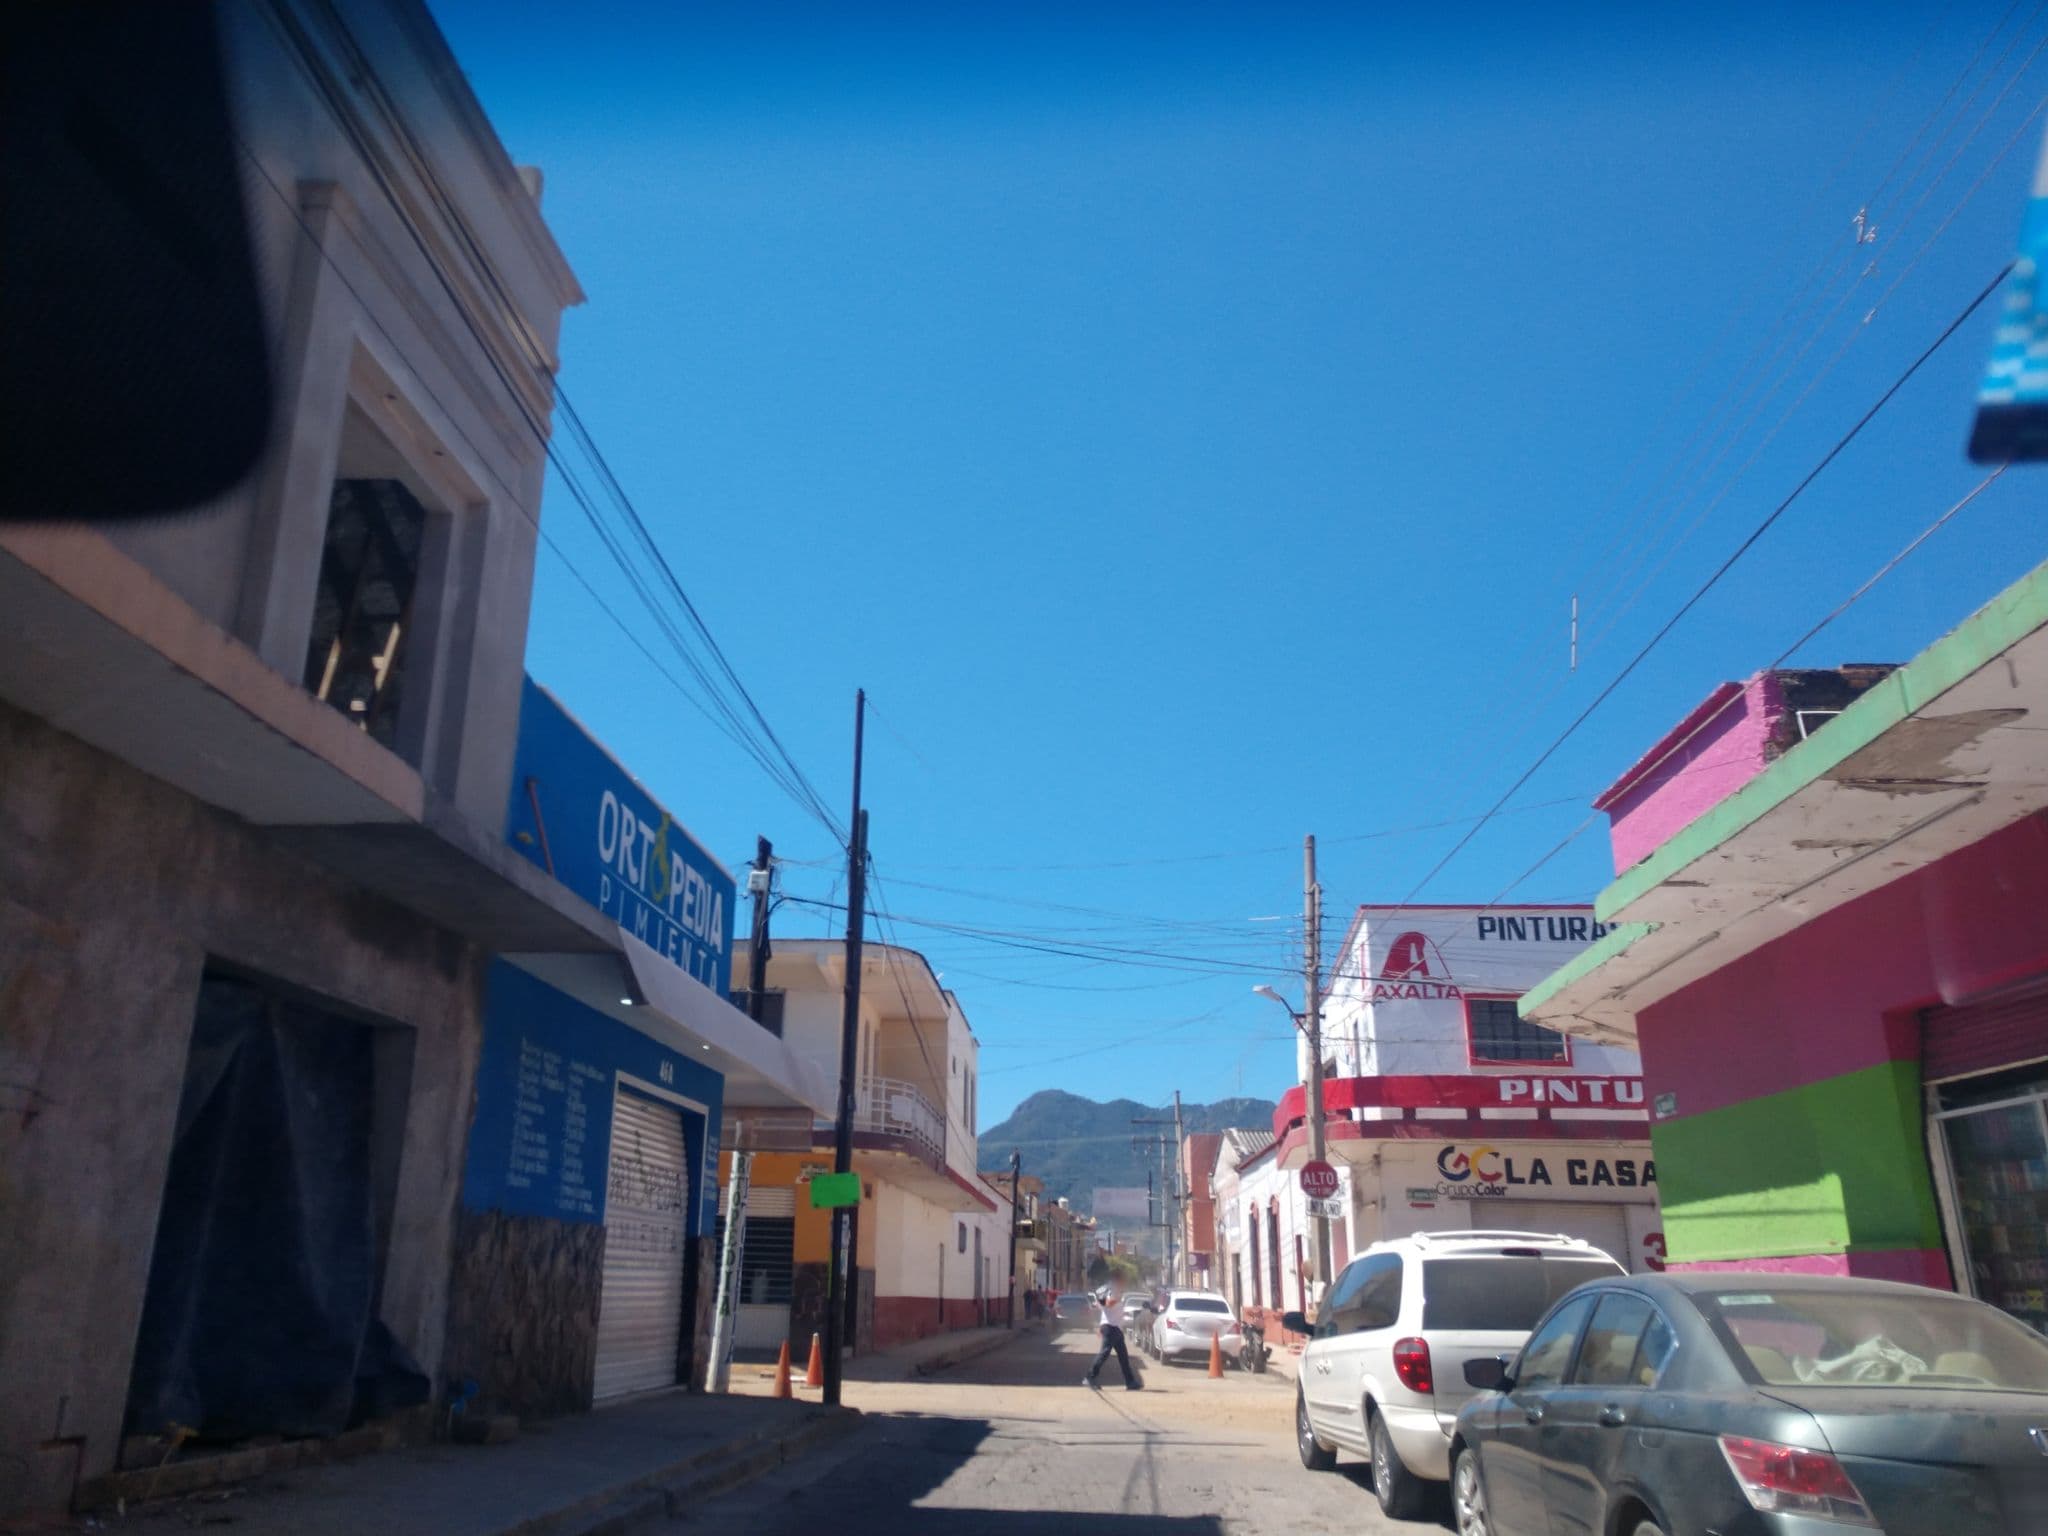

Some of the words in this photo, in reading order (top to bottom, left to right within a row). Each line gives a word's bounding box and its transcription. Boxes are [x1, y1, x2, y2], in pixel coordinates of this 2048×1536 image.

[599, 873, 718, 992] PIMIENTA
[1478, 916, 1617, 942] PINTURA
[1373, 984, 1463, 1000] AXALTA
[1500, 1079, 1644, 1103] PINTU
[1303, 1171, 1335, 1186] ALTO
[1504, 1158, 1552, 1185] LA
[1567, 1159, 1657, 1187] CASA
